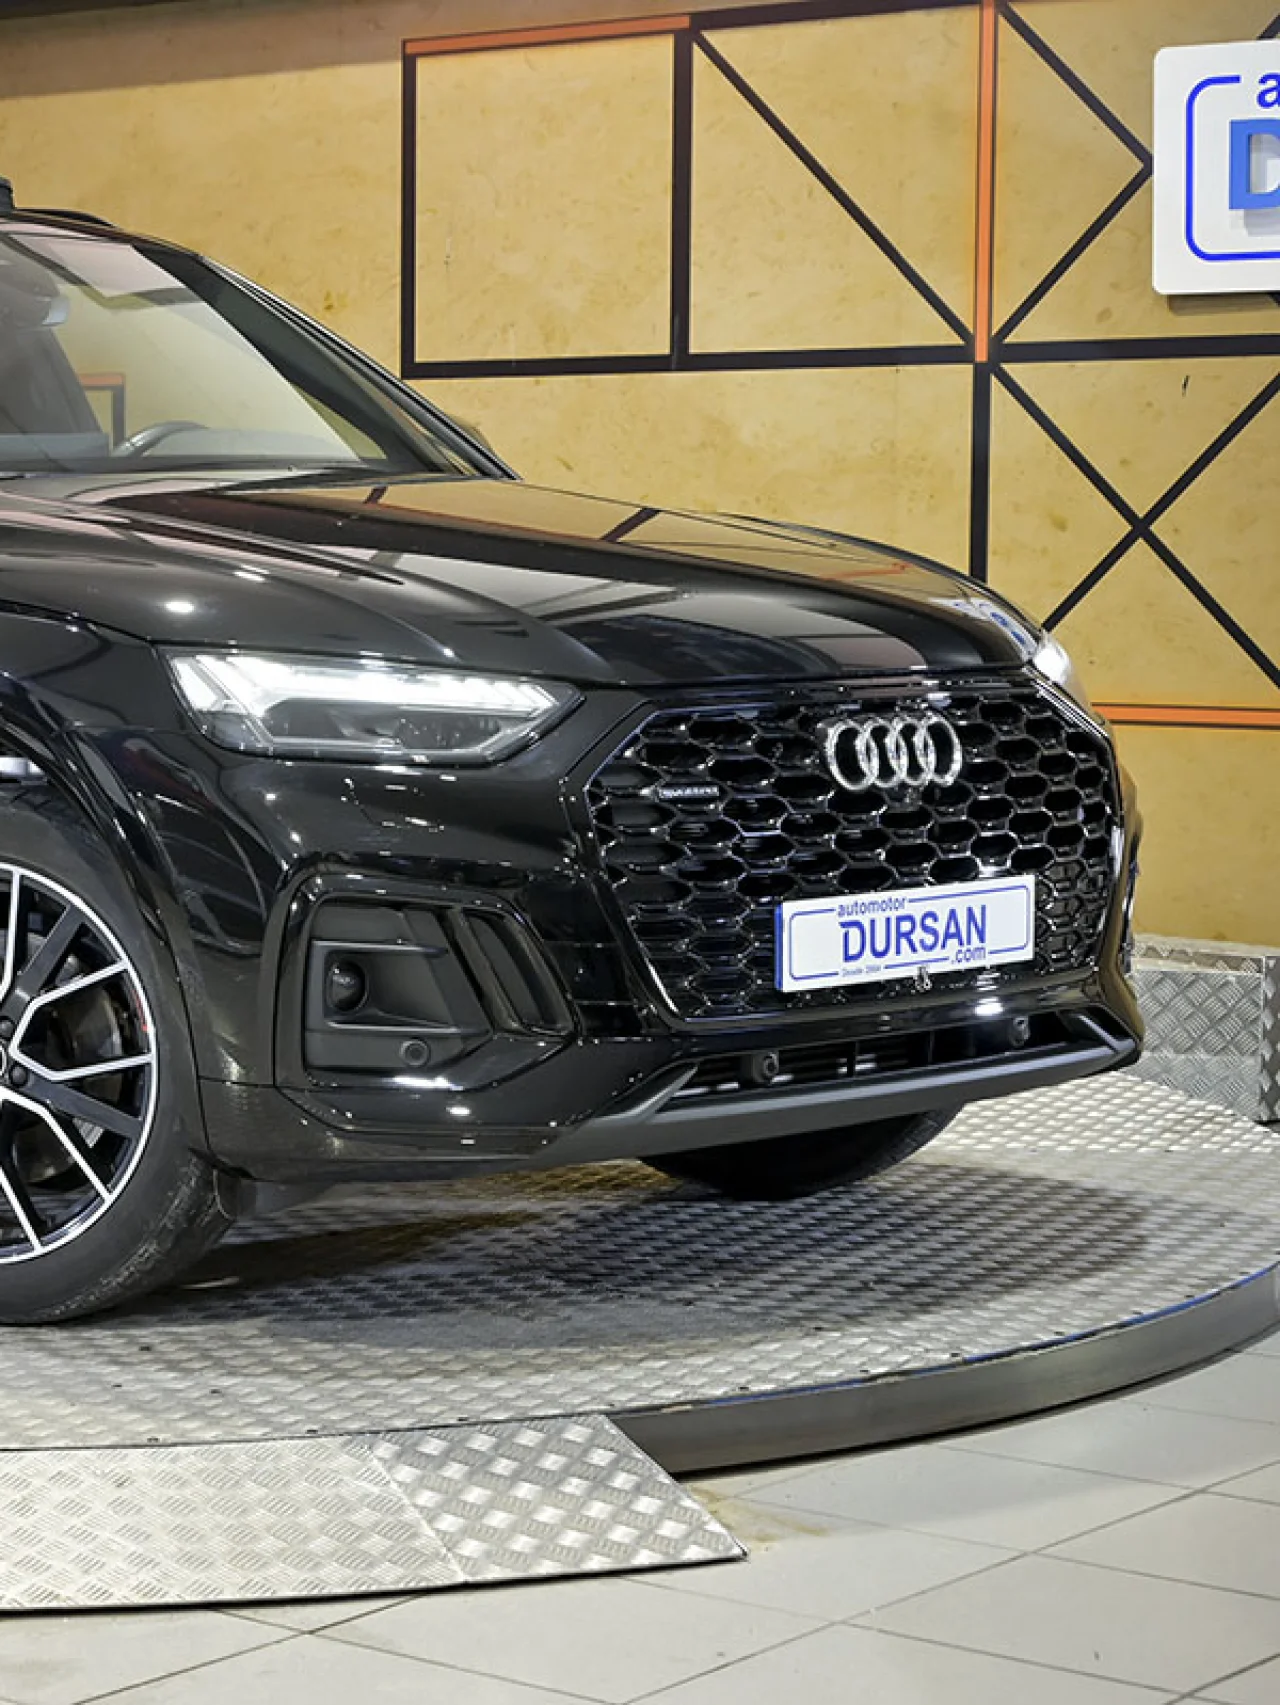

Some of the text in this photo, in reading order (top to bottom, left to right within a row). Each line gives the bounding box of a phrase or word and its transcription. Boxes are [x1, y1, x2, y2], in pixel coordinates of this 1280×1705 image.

[837, 897, 907, 917] automotor
[838, 904, 987, 963] DURSAN
[951, 946, 987, 964] .com
